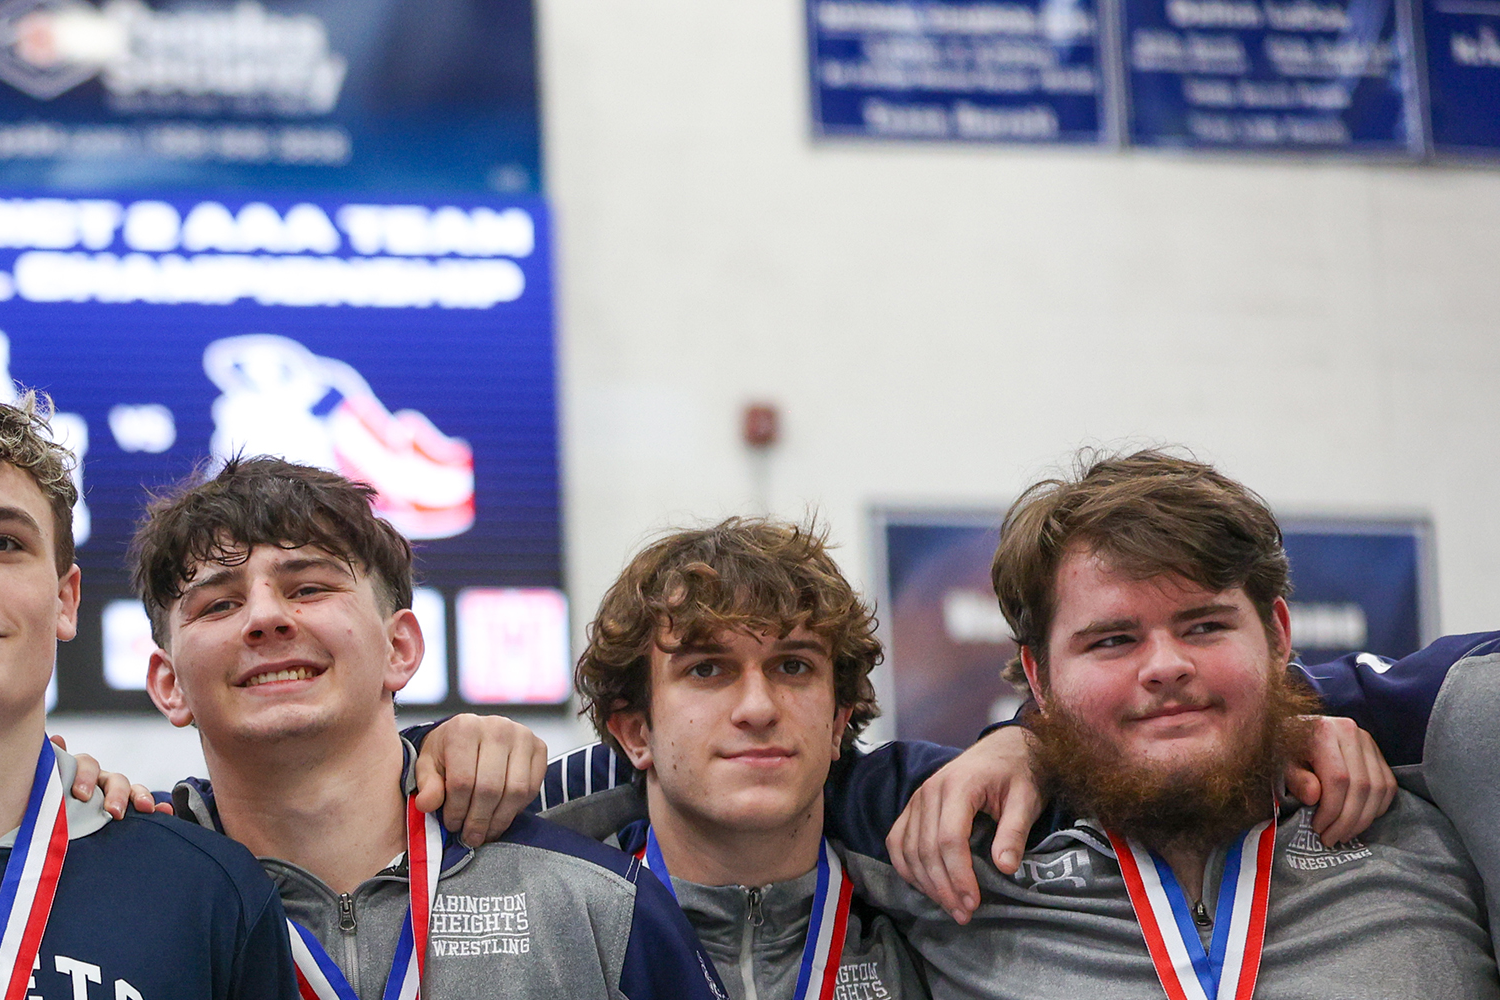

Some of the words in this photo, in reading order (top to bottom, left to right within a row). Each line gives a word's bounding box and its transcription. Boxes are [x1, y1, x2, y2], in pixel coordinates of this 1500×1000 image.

[1286, 849, 1373, 870] WRESTLING
[432, 892, 527, 914] ABINGTON
[431, 910, 529, 933] HEIGHTS
[431, 937, 530, 957] WRESTLING
[836, 962, 879, 985] GTON
